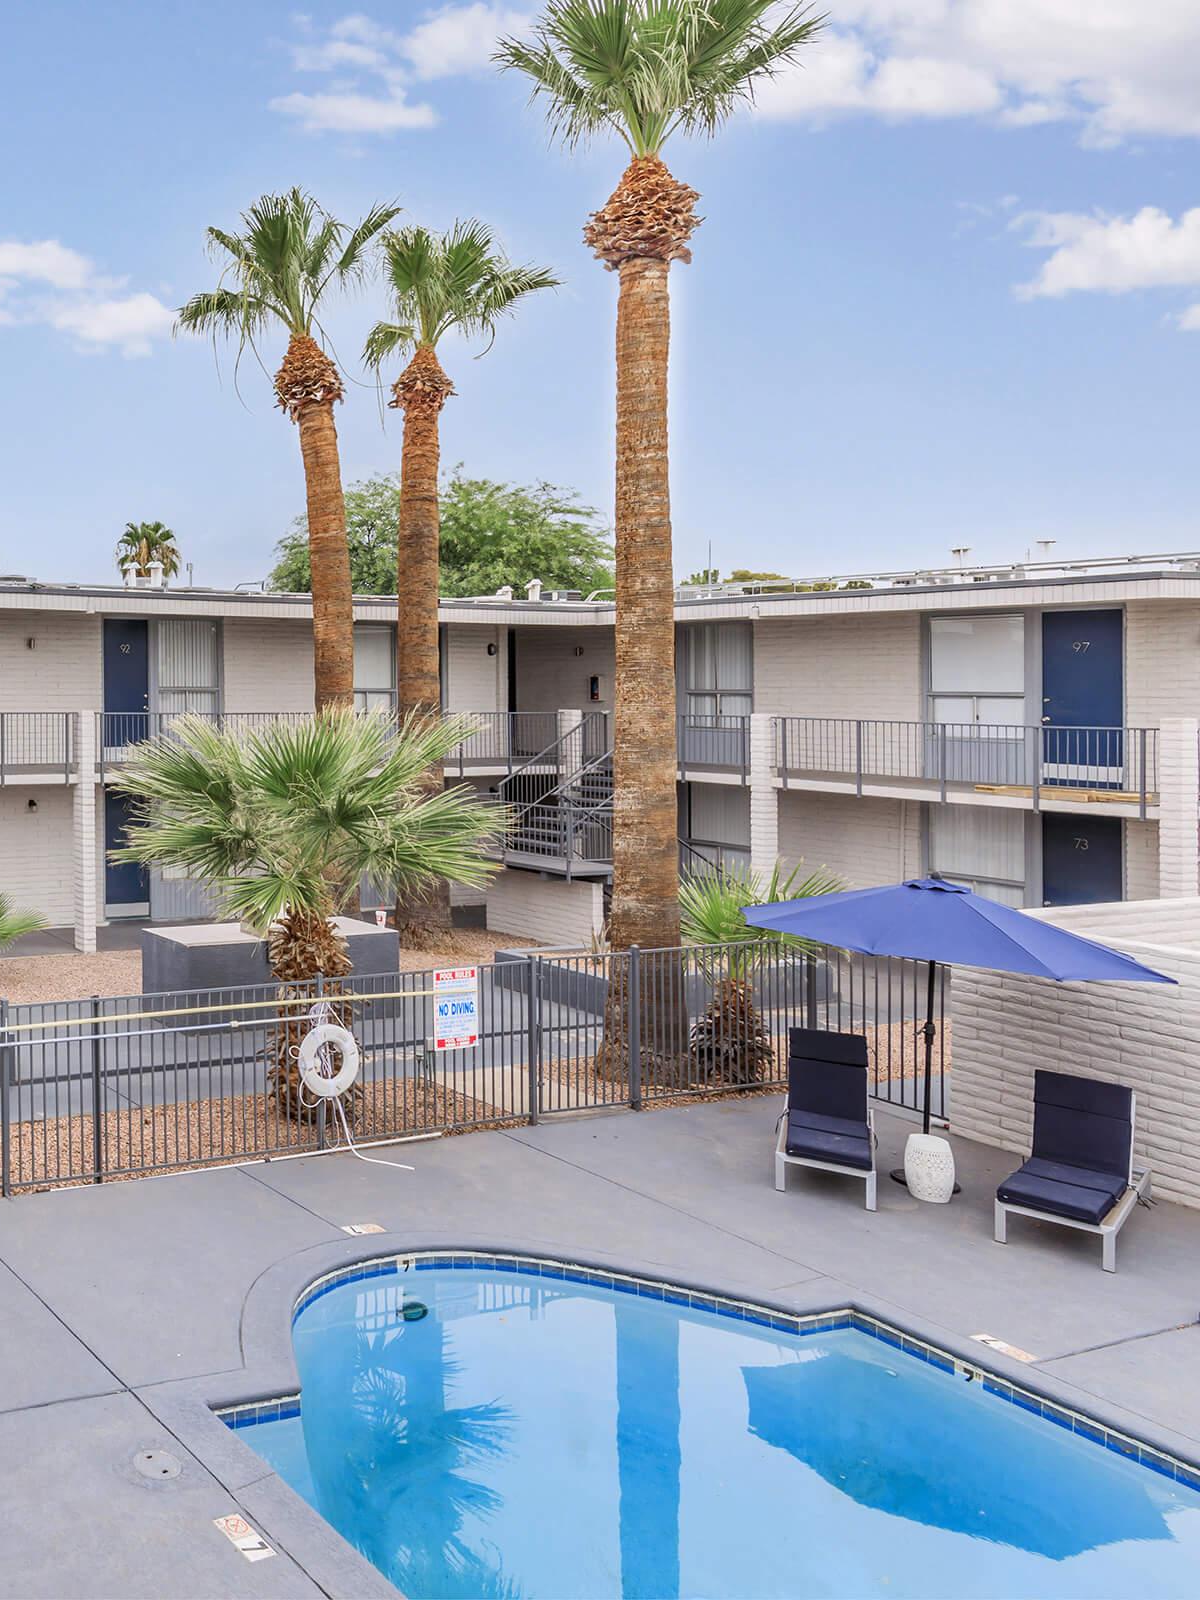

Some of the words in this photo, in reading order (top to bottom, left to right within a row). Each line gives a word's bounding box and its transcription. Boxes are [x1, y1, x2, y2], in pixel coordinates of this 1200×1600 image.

[120, 643, 130, 655] 92
[1072, 641, 1090, 653] 97
[1073, 838, 1089, 850] 73
[439, 1003, 449, 1017] NO
[451, 1001, 474, 1015] DIVING
[402, 1259, 410, 1272] 7
